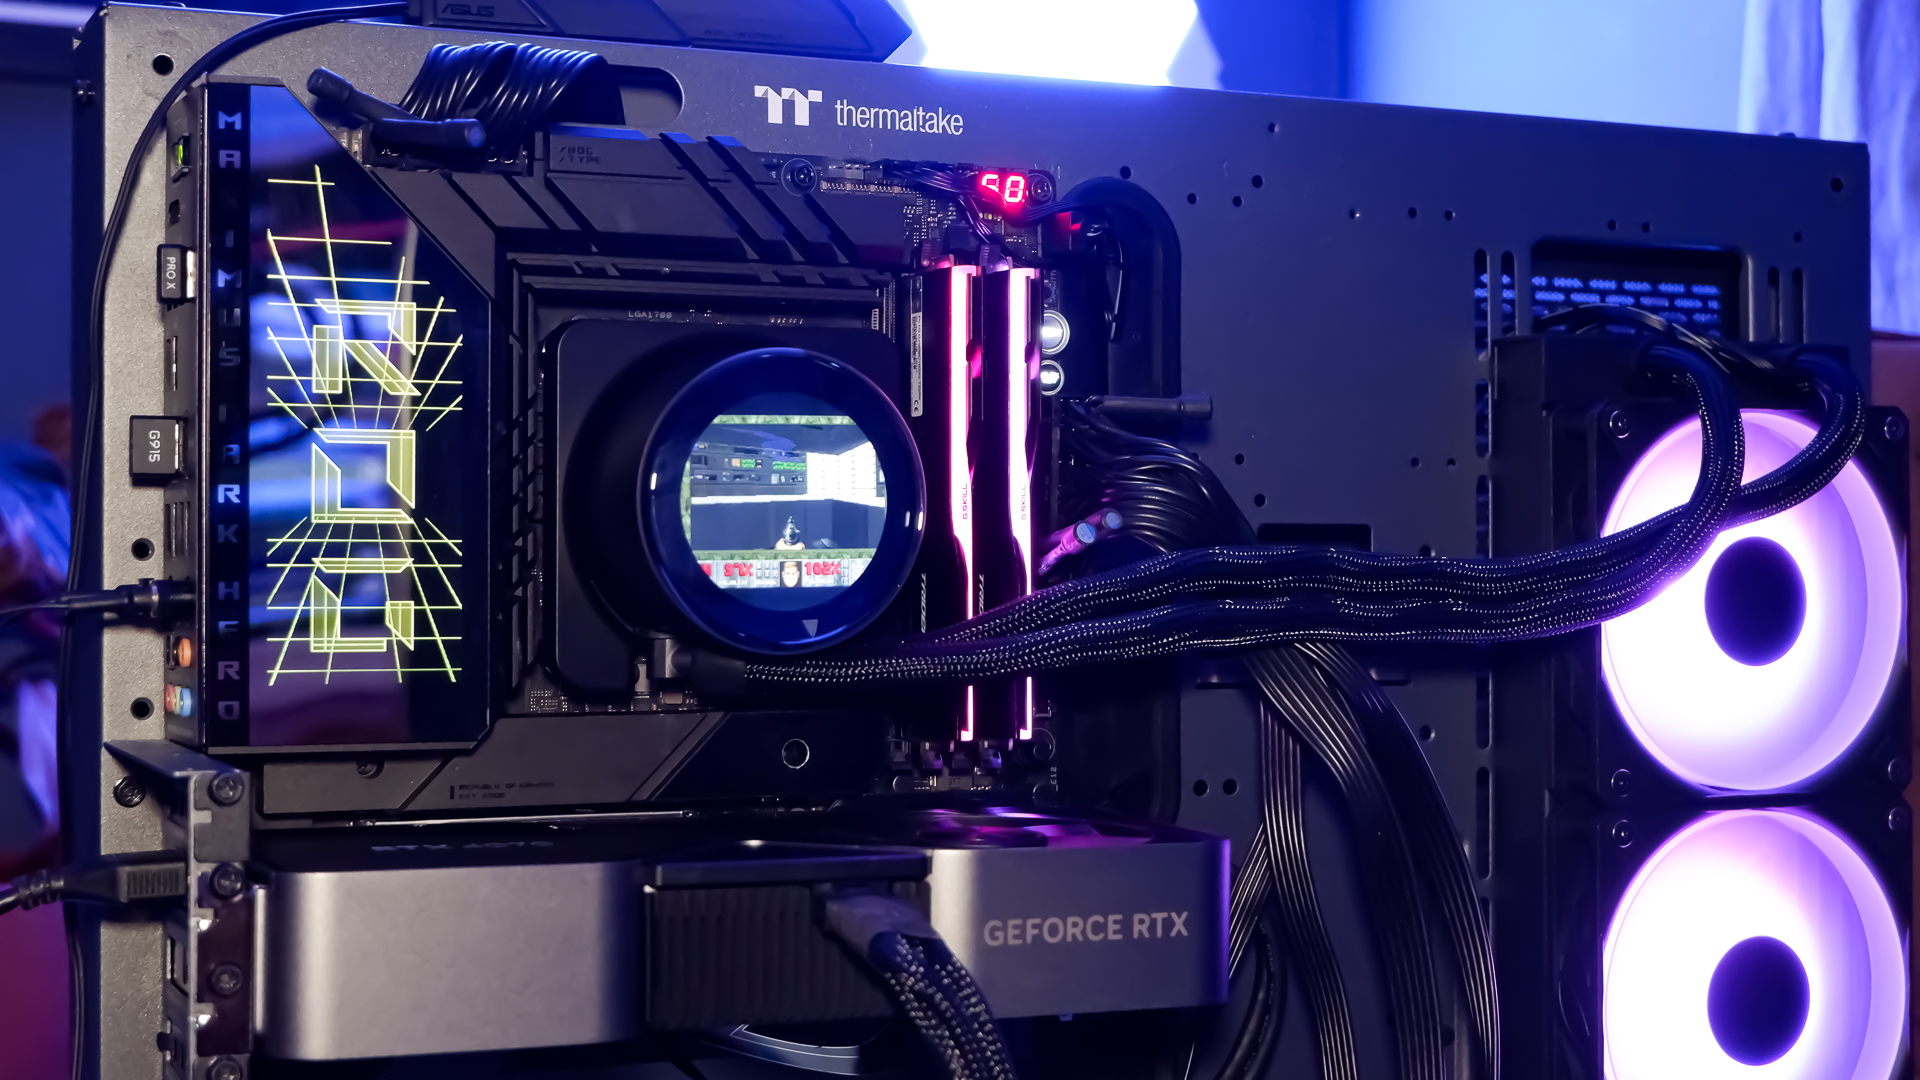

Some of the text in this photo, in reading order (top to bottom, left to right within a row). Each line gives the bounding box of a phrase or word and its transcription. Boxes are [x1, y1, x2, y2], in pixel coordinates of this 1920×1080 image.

[441, 3, 494, 18] ASUS
[834, 98, 964, 136] thermaltake
[166, 256, 177, 290] PRO X
[628, 310, 673, 319] LGA1700
[148, 430, 161, 463] G915
[217, 403, 241, 544] DARK
[723, 562, 754, 577] 97%
[804, 561, 842, 576] 102%
[217, 581, 241, 721] HERO
[984, 911, 1189, 947] GEFORCE RTX
